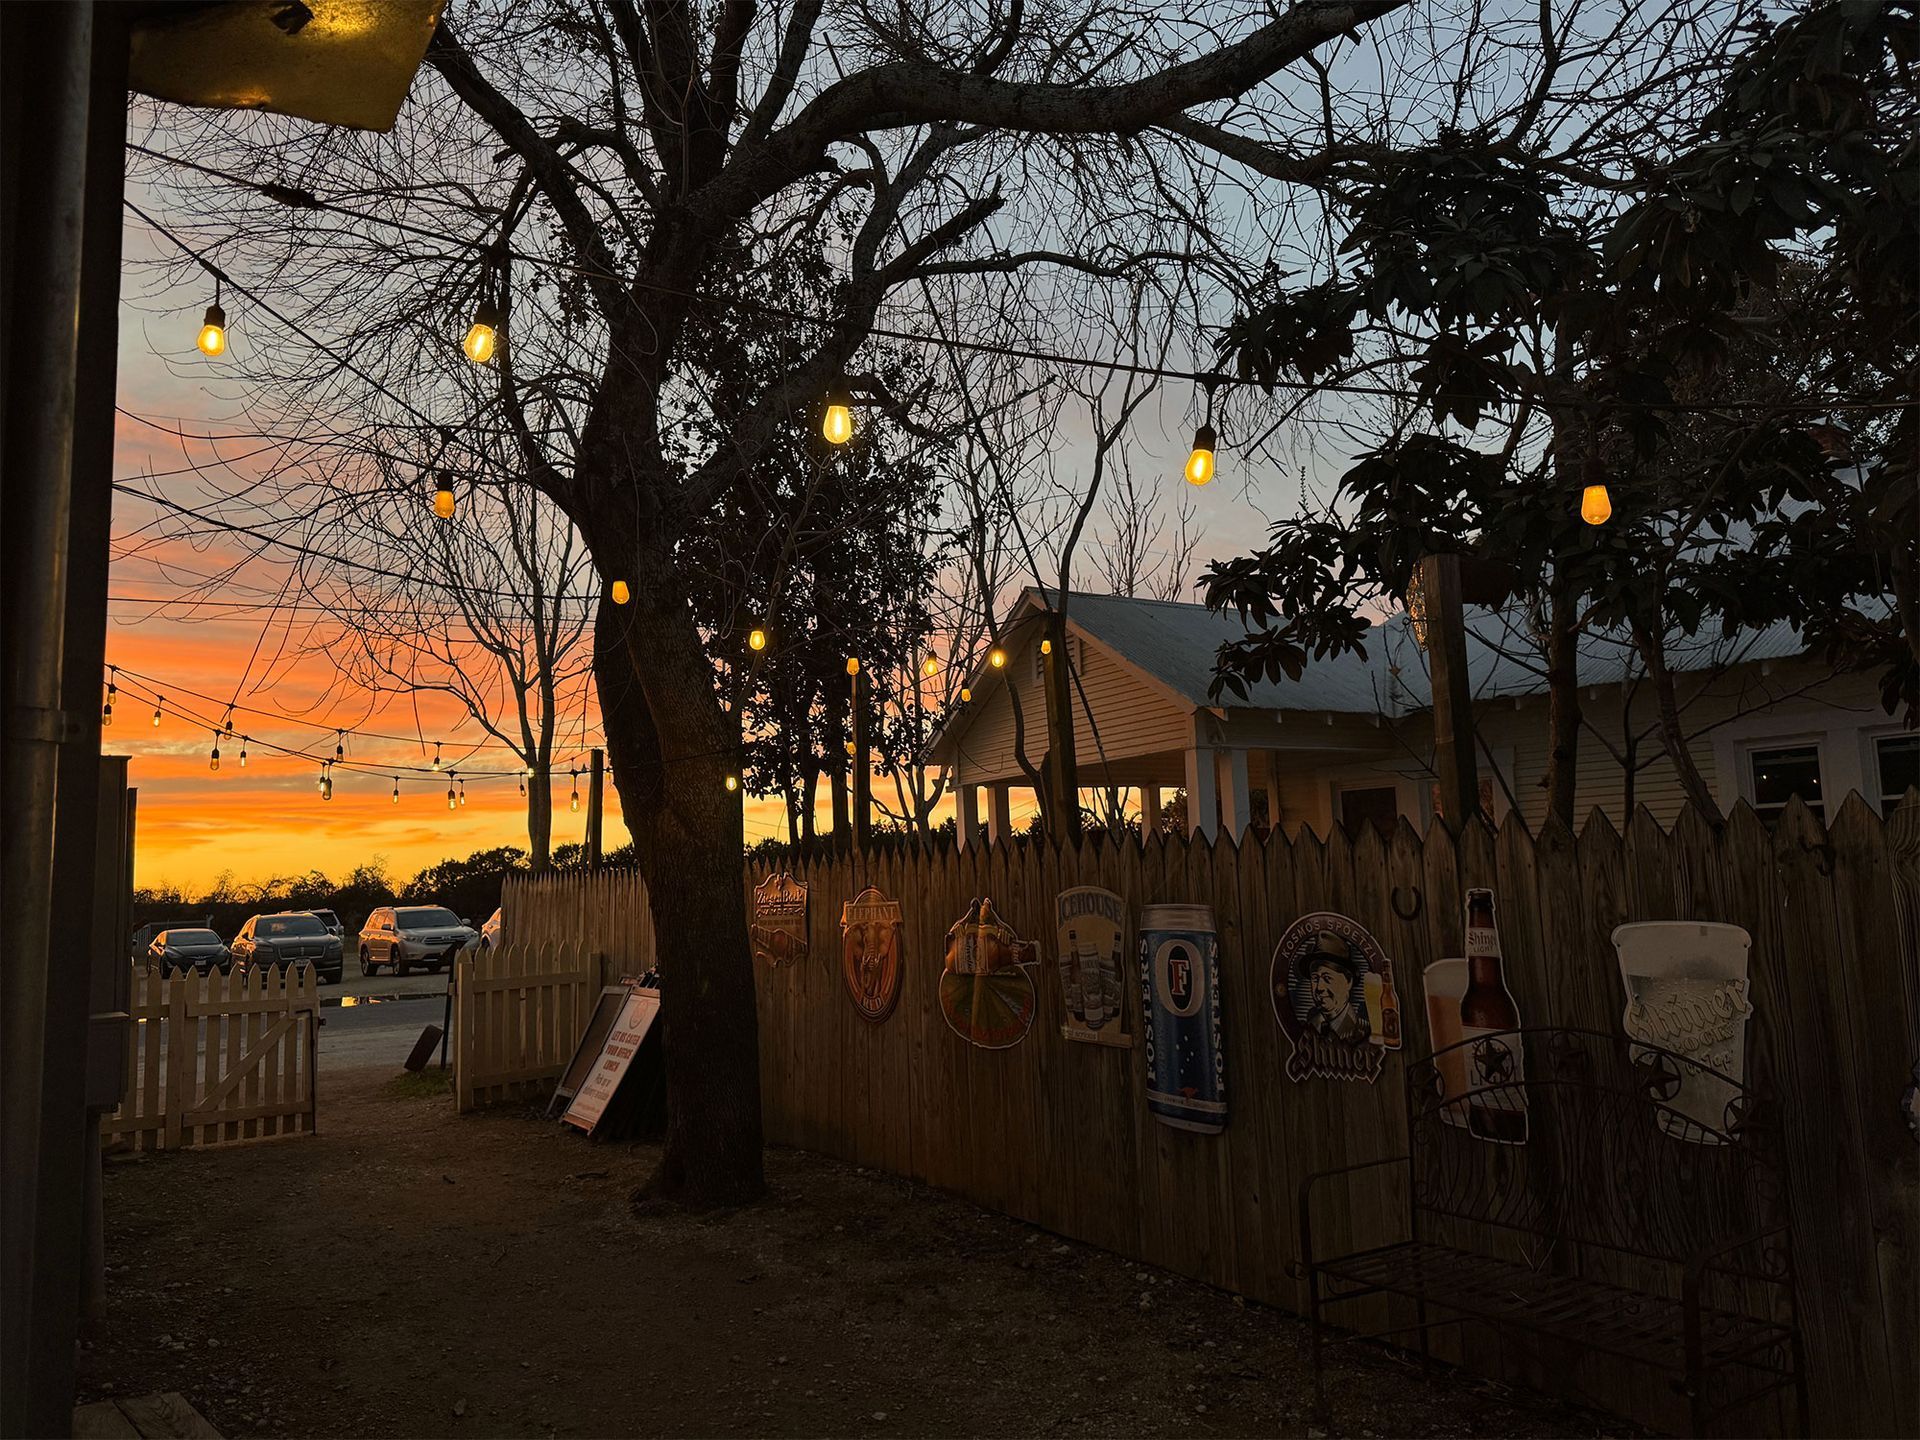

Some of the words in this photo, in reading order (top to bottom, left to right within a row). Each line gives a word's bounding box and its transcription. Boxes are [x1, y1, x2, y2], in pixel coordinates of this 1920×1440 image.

[847, 906, 896, 921] ELEPHANT
[1058, 893, 1122, 929] ICEHOUSE
[1281, 920, 1320, 959] KOSMOS
[1327, 920, 1377, 963] SPOETZL
[861, 997, 884, 1011] RED
[1628, 979, 1748, 1042] Shiner
[1291, 1028, 1378, 1072] Shiner
